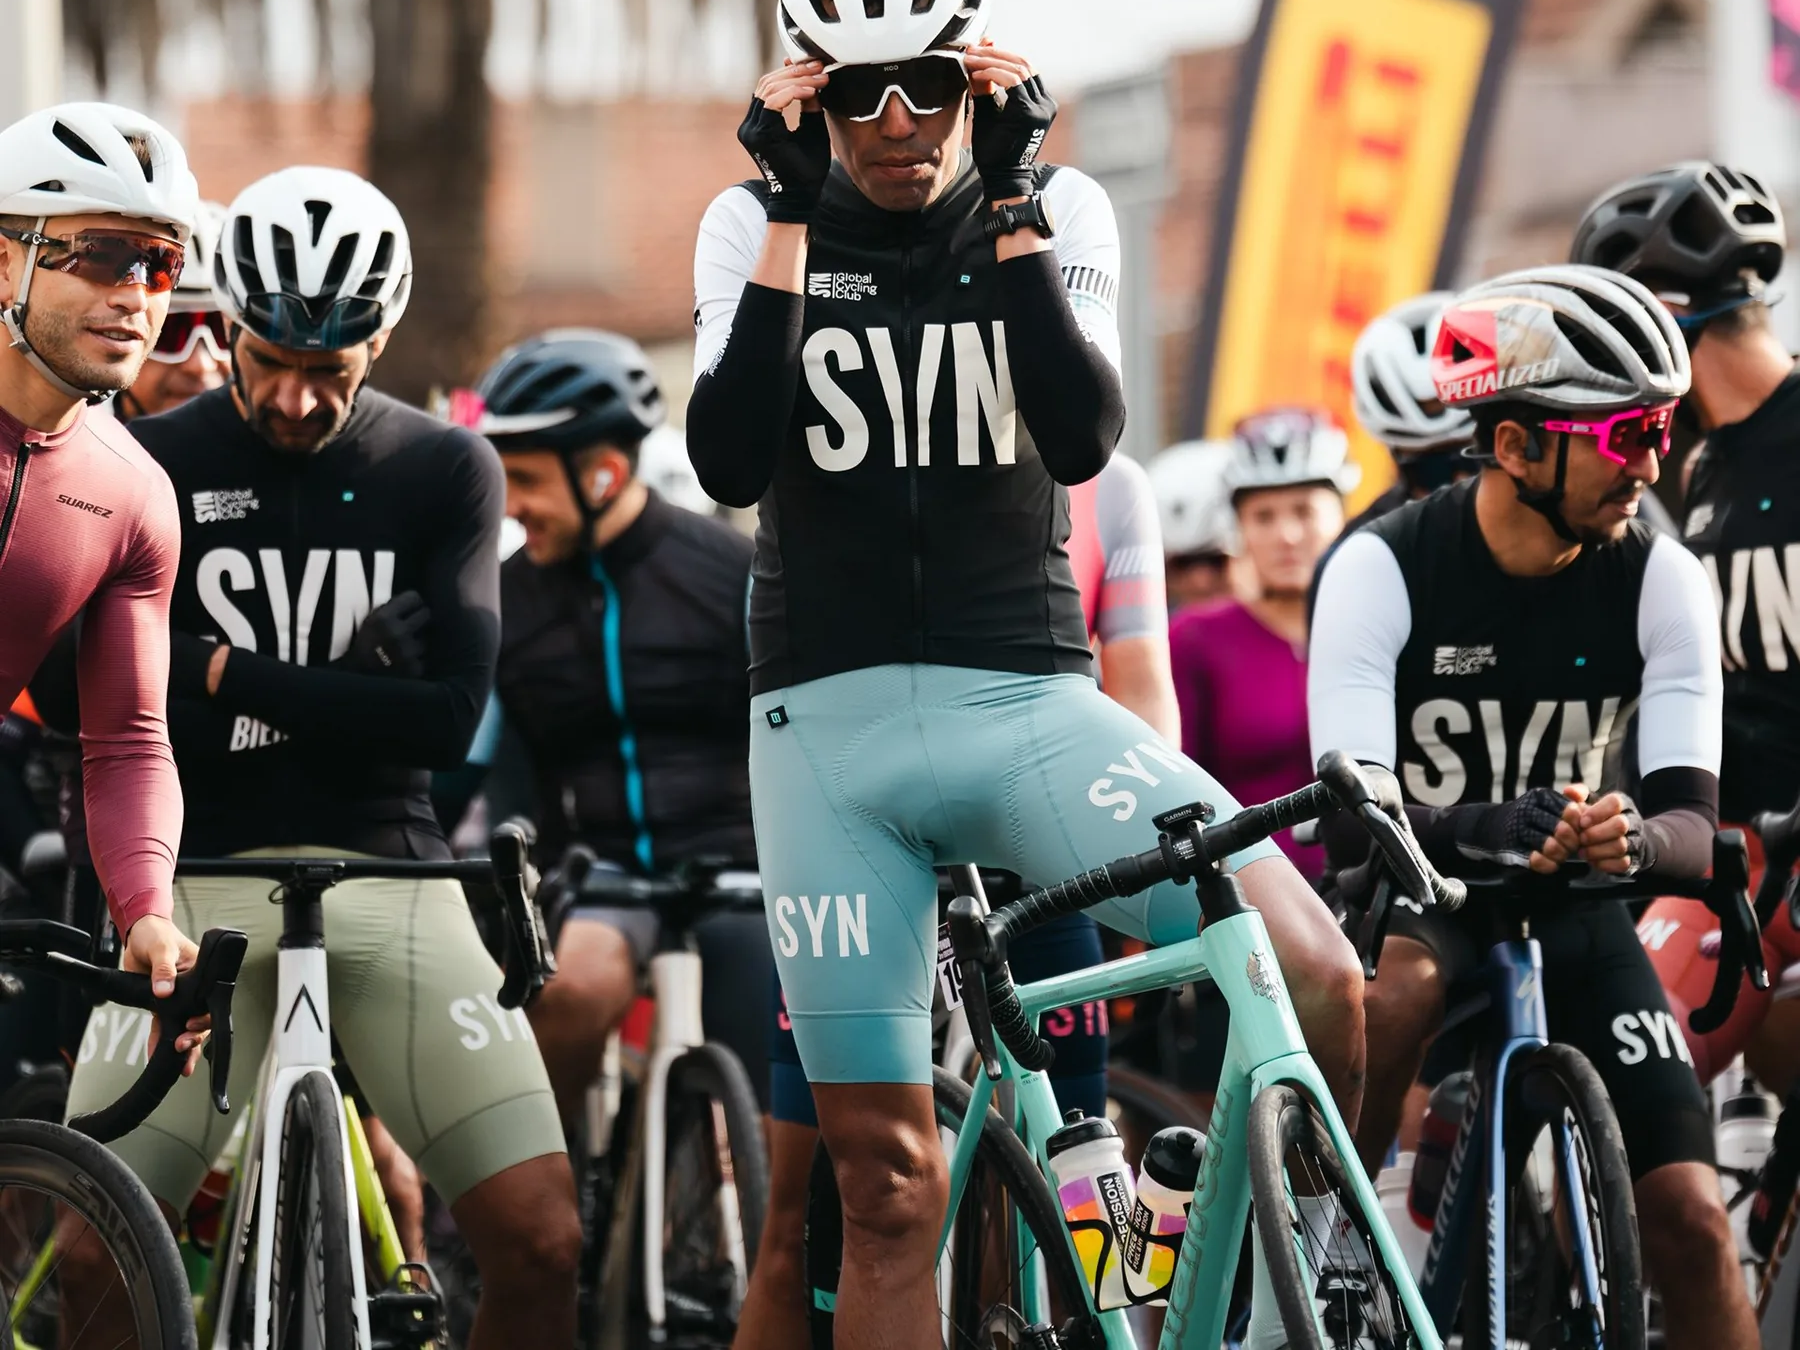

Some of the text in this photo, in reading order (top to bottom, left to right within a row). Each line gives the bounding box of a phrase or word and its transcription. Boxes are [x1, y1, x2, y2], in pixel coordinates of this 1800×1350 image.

[808, 273, 832, 298] SYN
[836, 272, 872, 284] Global
[836, 281, 878, 296] Cycling
[836, 290, 862, 301] Club
[802, 320, 1016, 472] SYN
[1439, 357, 1561, 401] SPECIALIZED
[56, 494, 113, 519] SUAREZ
[197, 548, 395, 667] SYN
[1403, 697, 1621, 808] SYN
[1088, 739, 1199, 821] SYN
[1163, 808, 1192, 823] GARMIN
[774, 894, 870, 958] SYN
